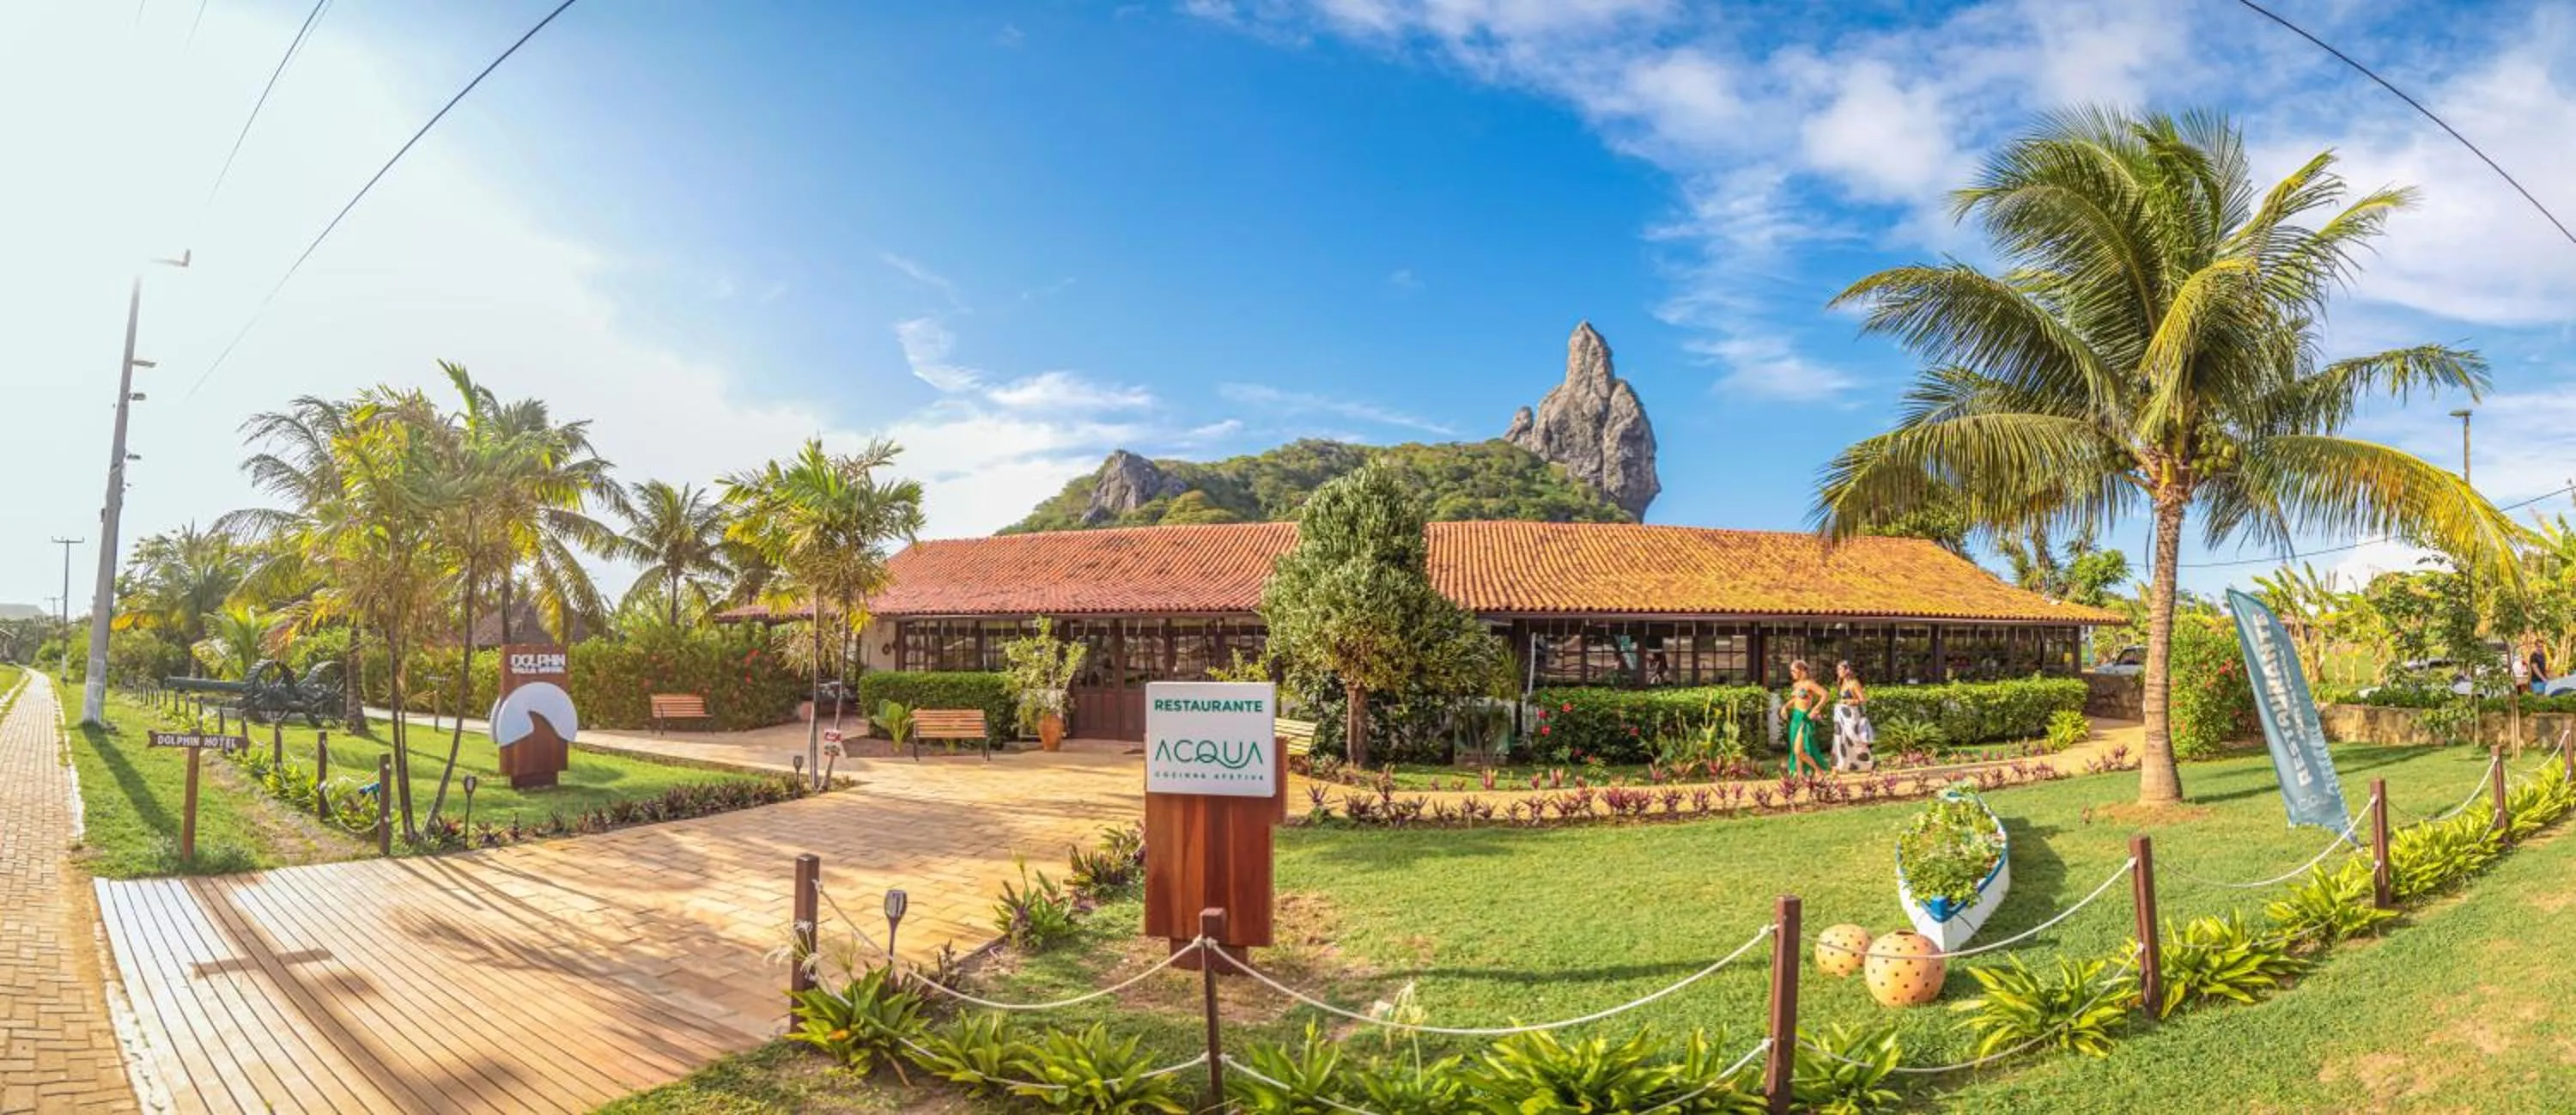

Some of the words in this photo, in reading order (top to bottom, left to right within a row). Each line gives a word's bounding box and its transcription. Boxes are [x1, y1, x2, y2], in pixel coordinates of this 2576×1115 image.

[511, 654, 565, 667] DOLPHIN
[1154, 699, 1263, 712] RESTAURANTE
[2253, 612, 2312, 787] RESTAURANTE
[157, 734, 200, 746] DOLPHIN
[204, 736, 236, 747] HOTEL
[1155, 739, 1263, 770] ACQUA
